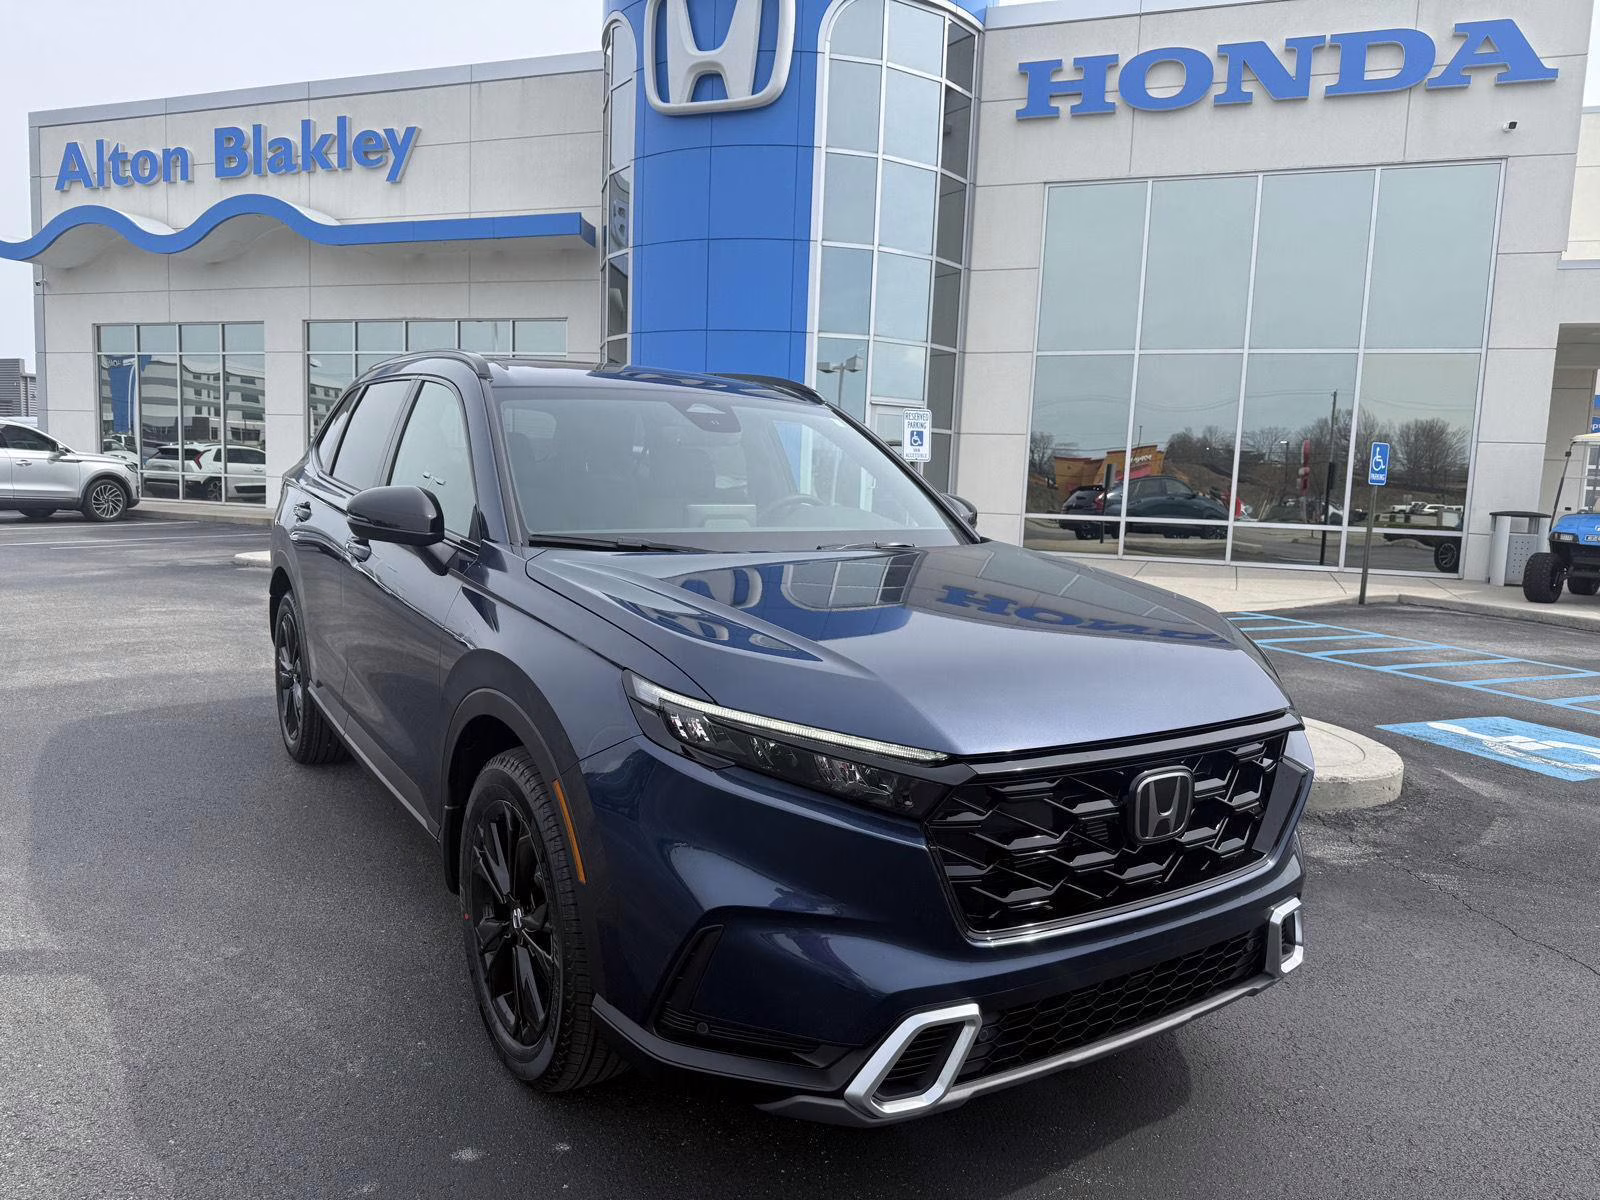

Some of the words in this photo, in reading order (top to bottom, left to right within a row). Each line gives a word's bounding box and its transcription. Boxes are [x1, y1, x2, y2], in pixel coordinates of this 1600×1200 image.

[1015, 18, 1560, 121] HONDA
[55, 138, 194, 192] Alton
[214, 115, 421, 184] Blakley
[905, 412, 929, 422] RESERVED
[907, 421, 927, 430] PARKING
